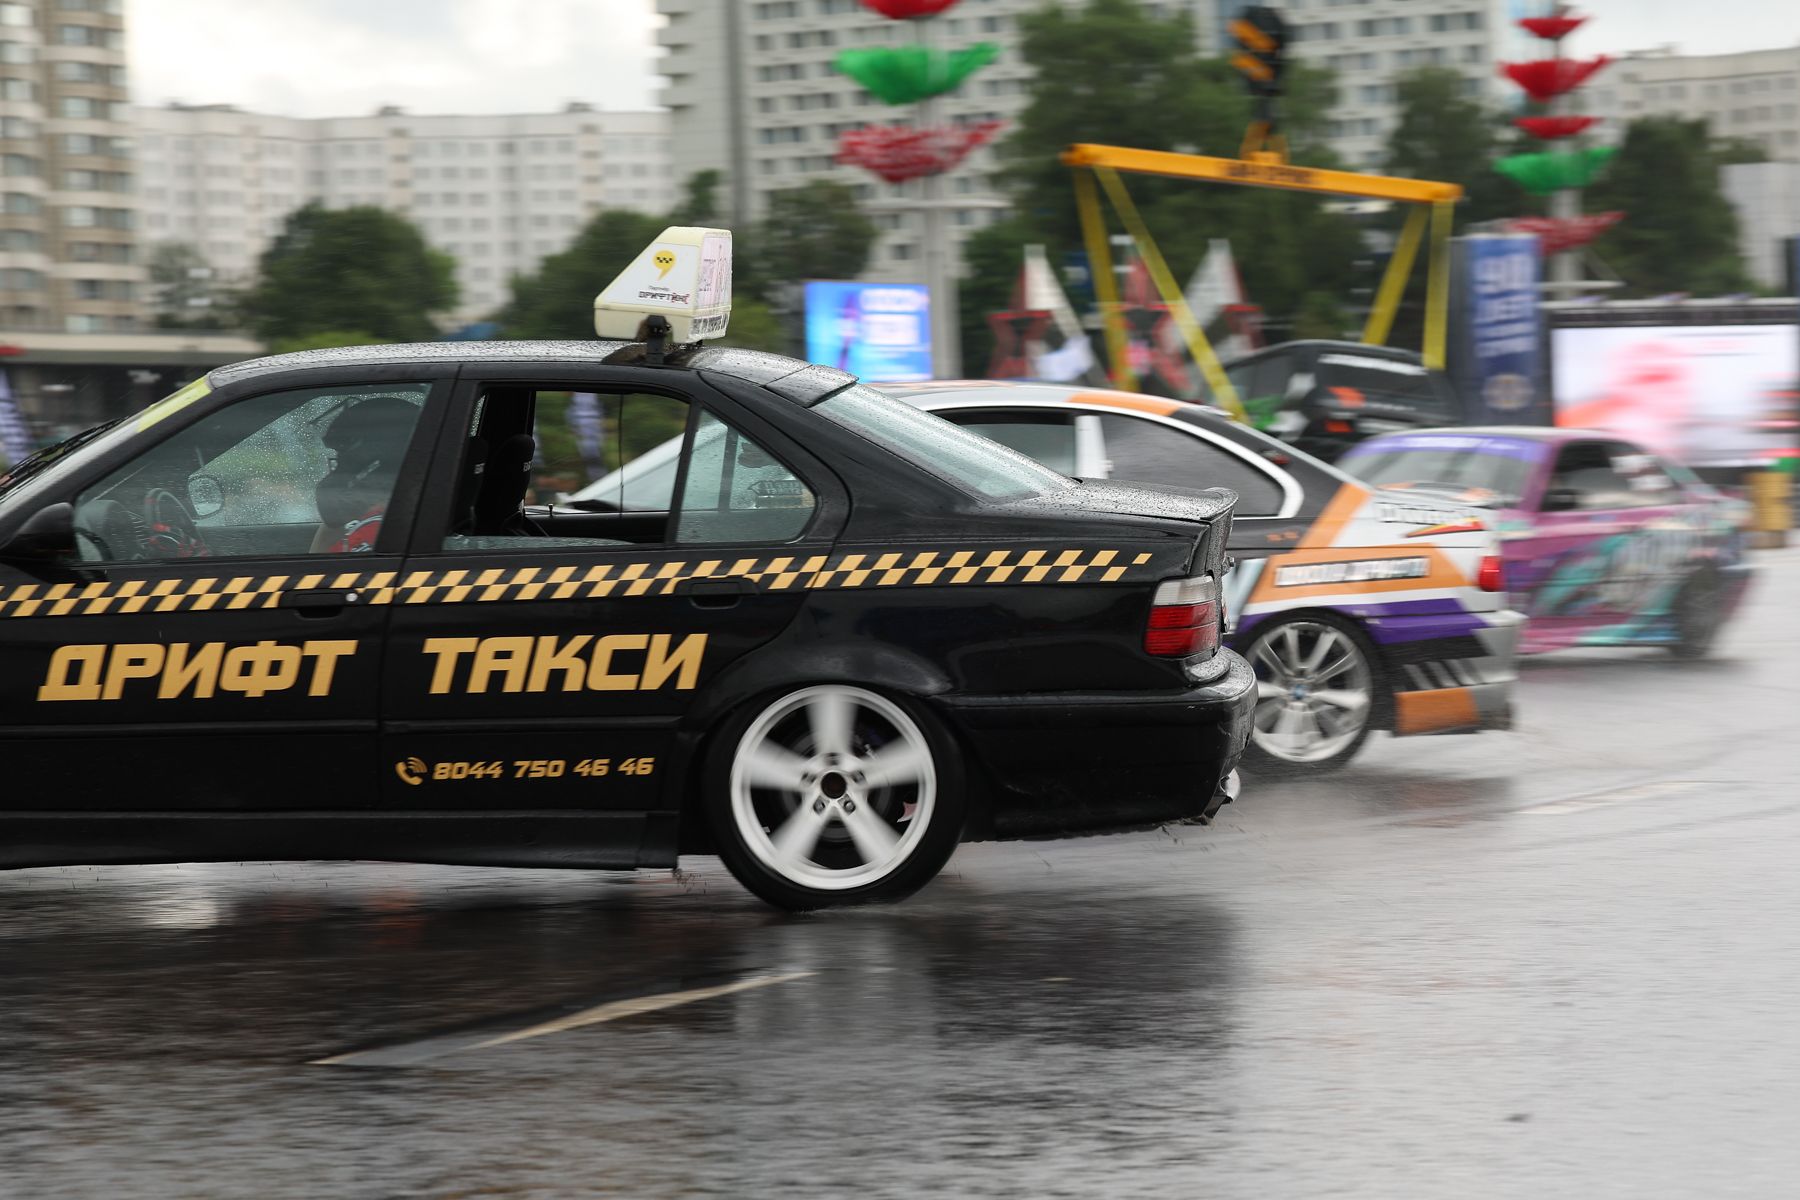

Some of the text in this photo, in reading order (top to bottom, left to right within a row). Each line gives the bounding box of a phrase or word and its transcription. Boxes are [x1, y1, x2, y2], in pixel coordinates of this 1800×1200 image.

[38, 633, 708, 702] ДРИФТ ТАКСИ
[433, 757, 654, 780] 8044 750 46 46
